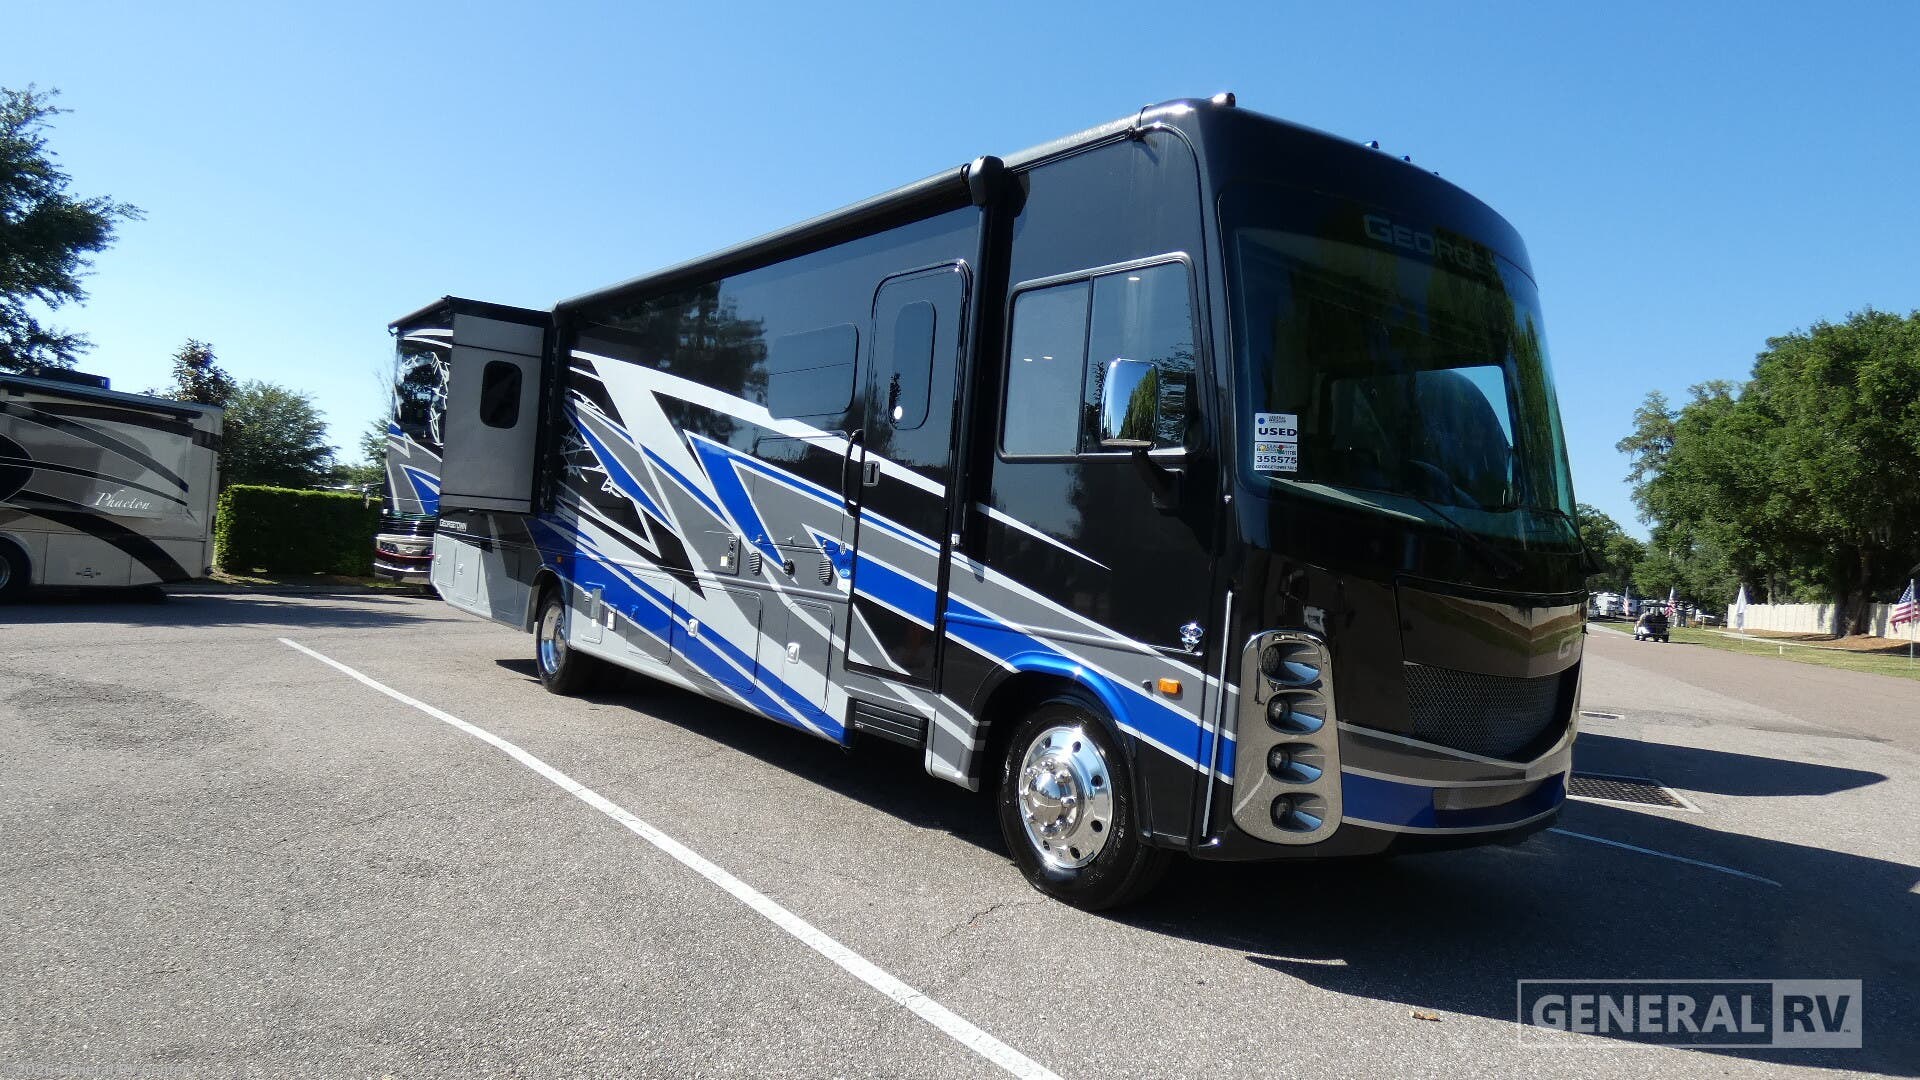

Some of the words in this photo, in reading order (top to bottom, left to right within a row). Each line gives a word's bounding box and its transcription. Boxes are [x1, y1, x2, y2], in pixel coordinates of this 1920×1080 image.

[1258, 427, 1297, 436] USED
[1256, 455, 1297, 464] 355575
[95, 489, 151, 510] Phaeton
